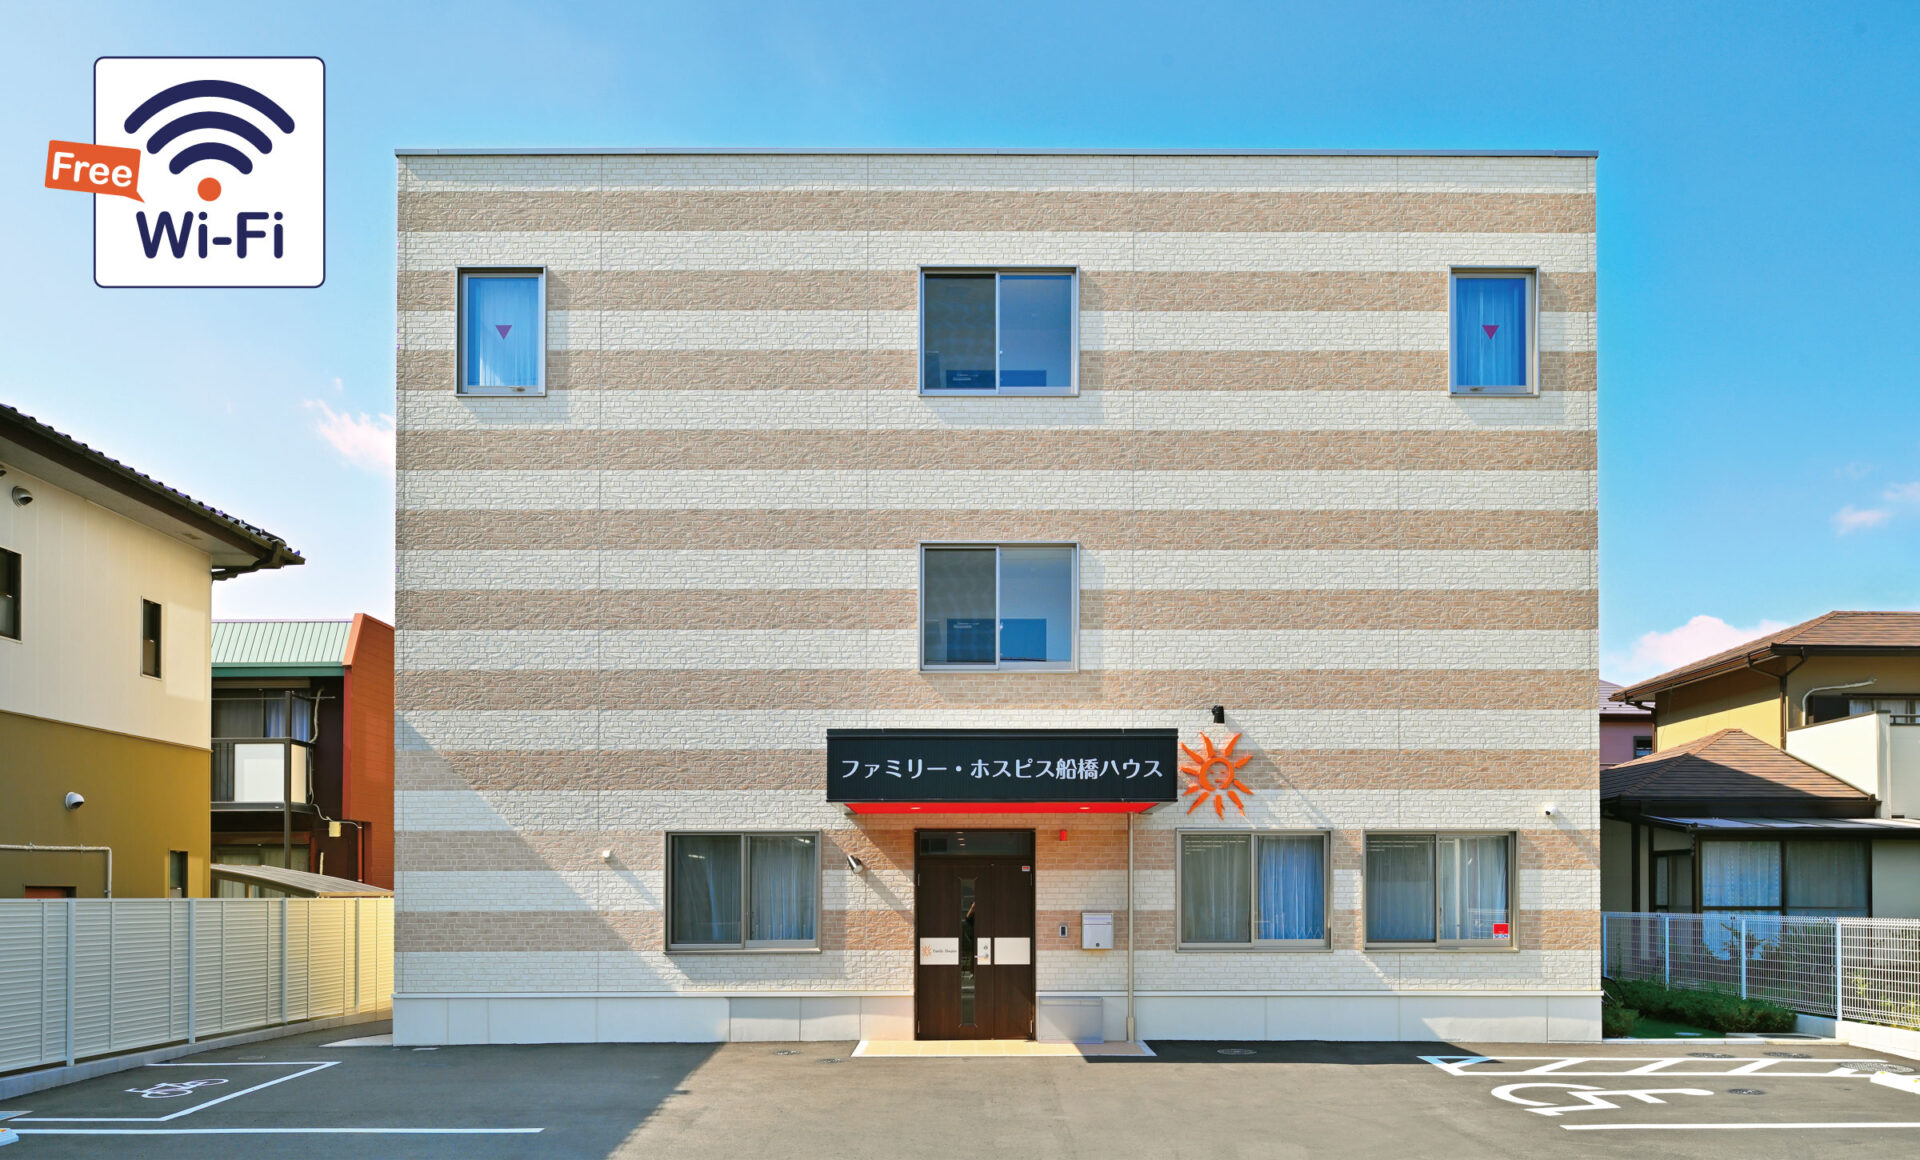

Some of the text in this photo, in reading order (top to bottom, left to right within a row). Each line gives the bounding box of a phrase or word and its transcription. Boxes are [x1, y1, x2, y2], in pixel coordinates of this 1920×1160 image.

[841, 758, 1163, 780] ファミリー・ホスピス船橋ハウス
